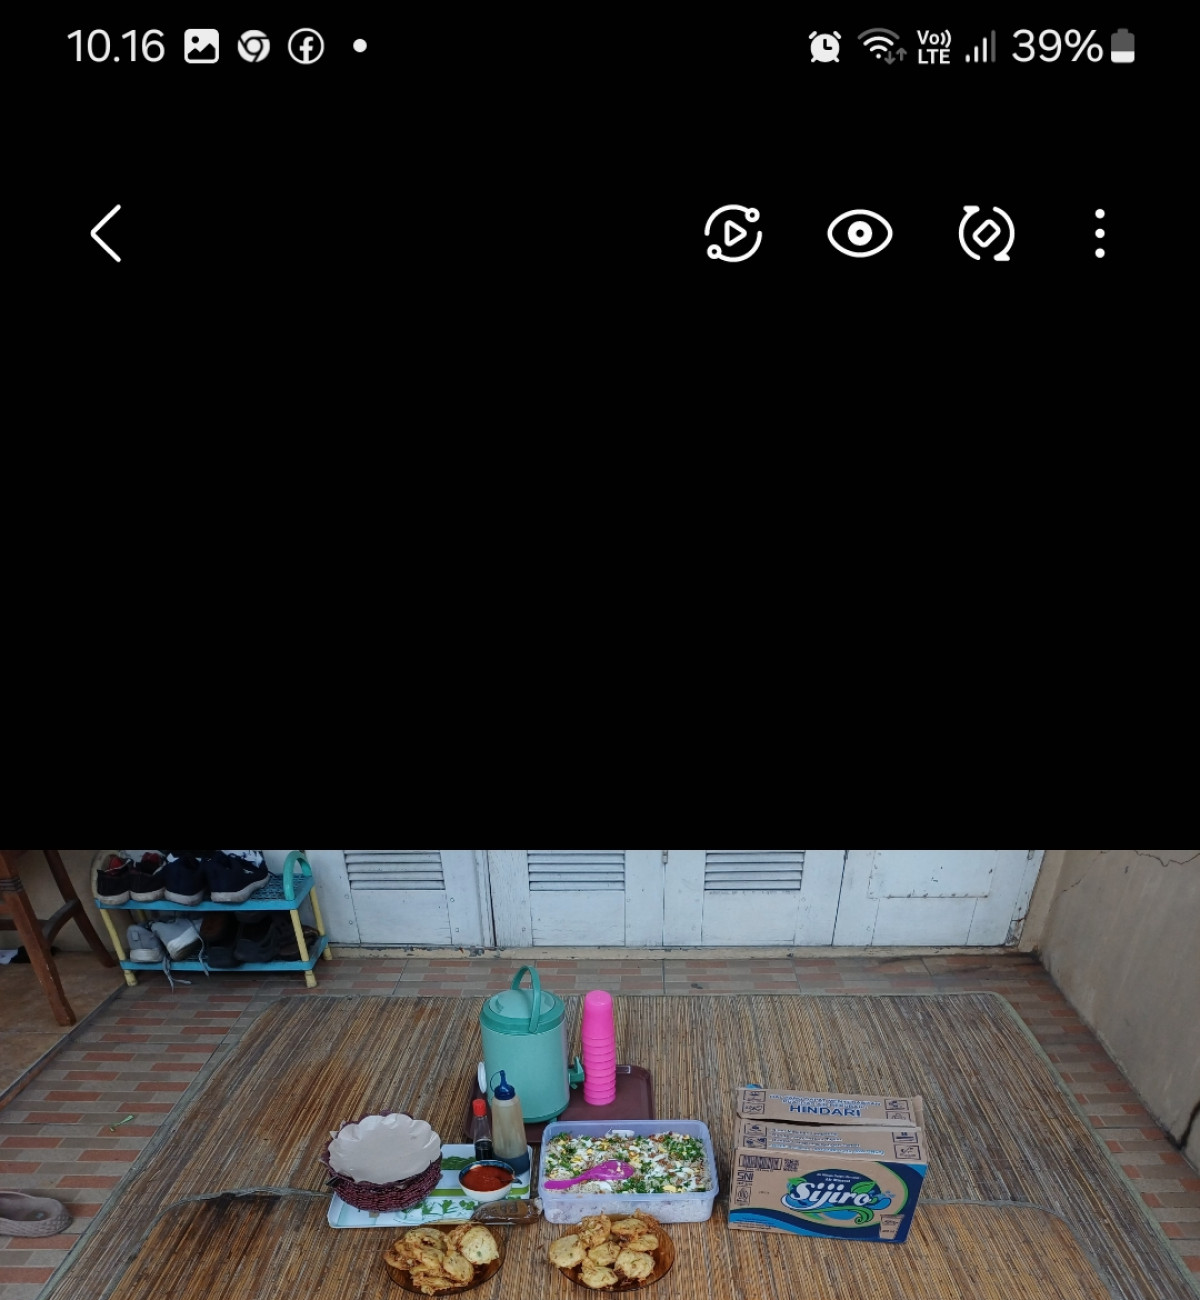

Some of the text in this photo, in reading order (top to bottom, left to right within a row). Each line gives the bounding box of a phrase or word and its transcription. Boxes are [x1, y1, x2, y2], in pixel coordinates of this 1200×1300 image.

[68, 29, 164, 63] 10.16
[918, 48, 951, 65] LTE
[1013, 29, 1104, 63] 39%
[789, 1104, 862, 1118] HINDARI
[785, 1182, 871, 1208] Sijiro
